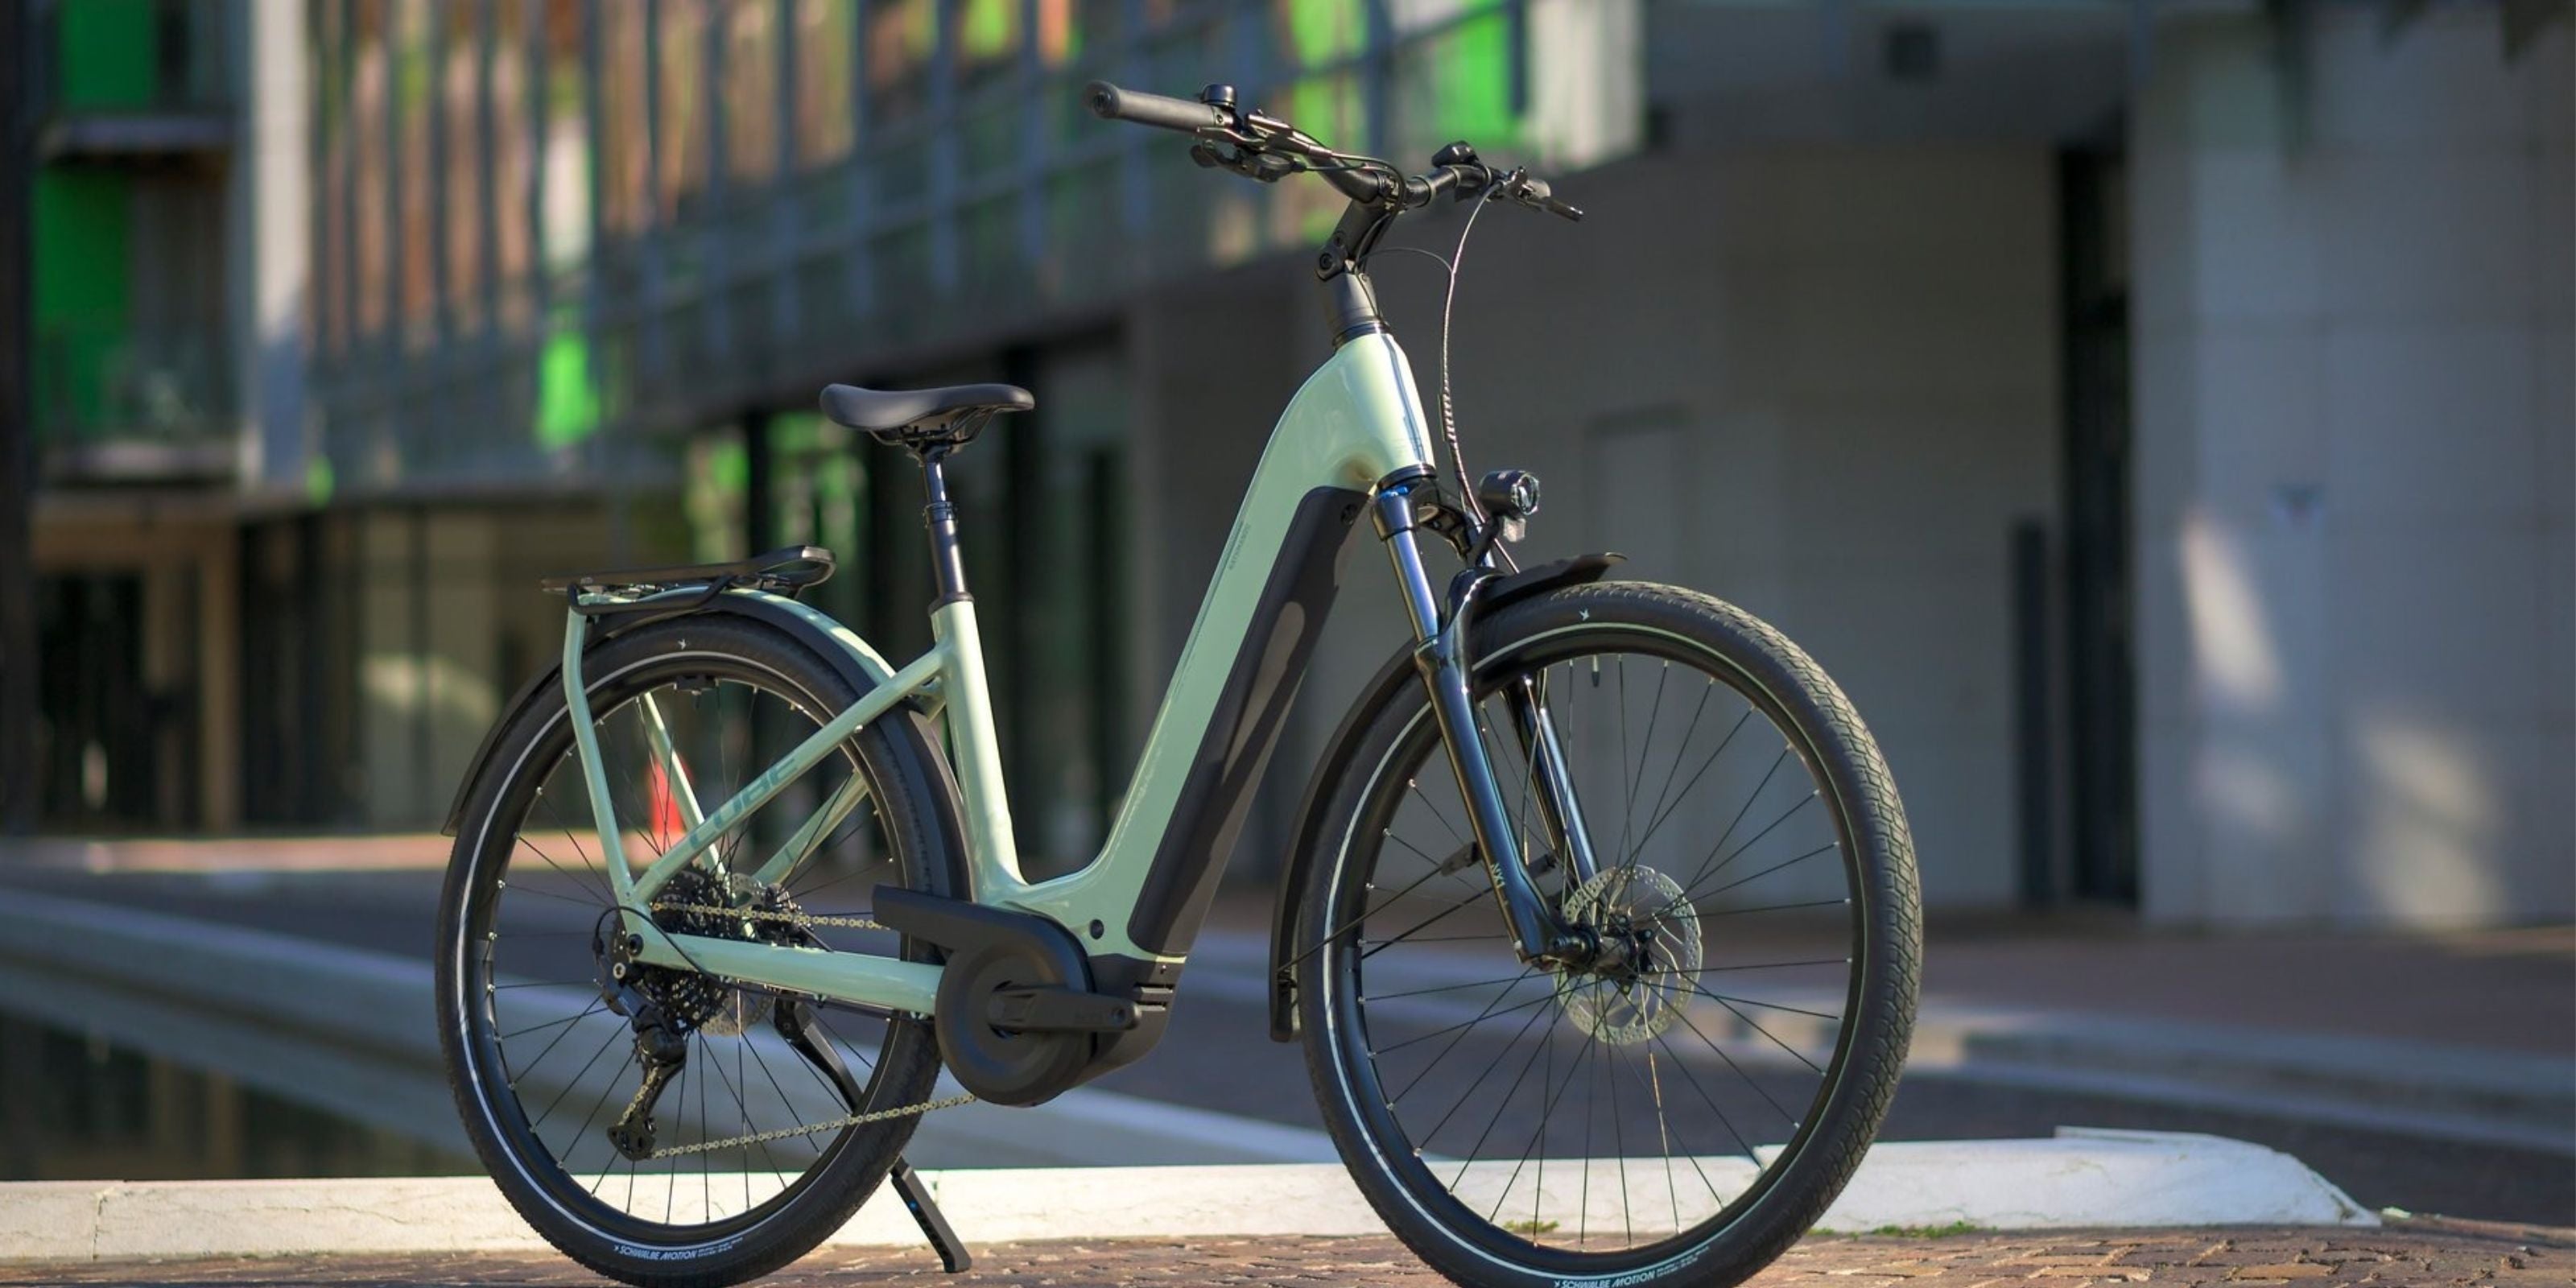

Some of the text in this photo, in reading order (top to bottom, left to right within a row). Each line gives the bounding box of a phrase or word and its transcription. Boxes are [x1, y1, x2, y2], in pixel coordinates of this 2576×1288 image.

[621, 1245, 697, 1261] SCHWALBE MOTION
[1612, 1271, 1655, 1288] MOTION
